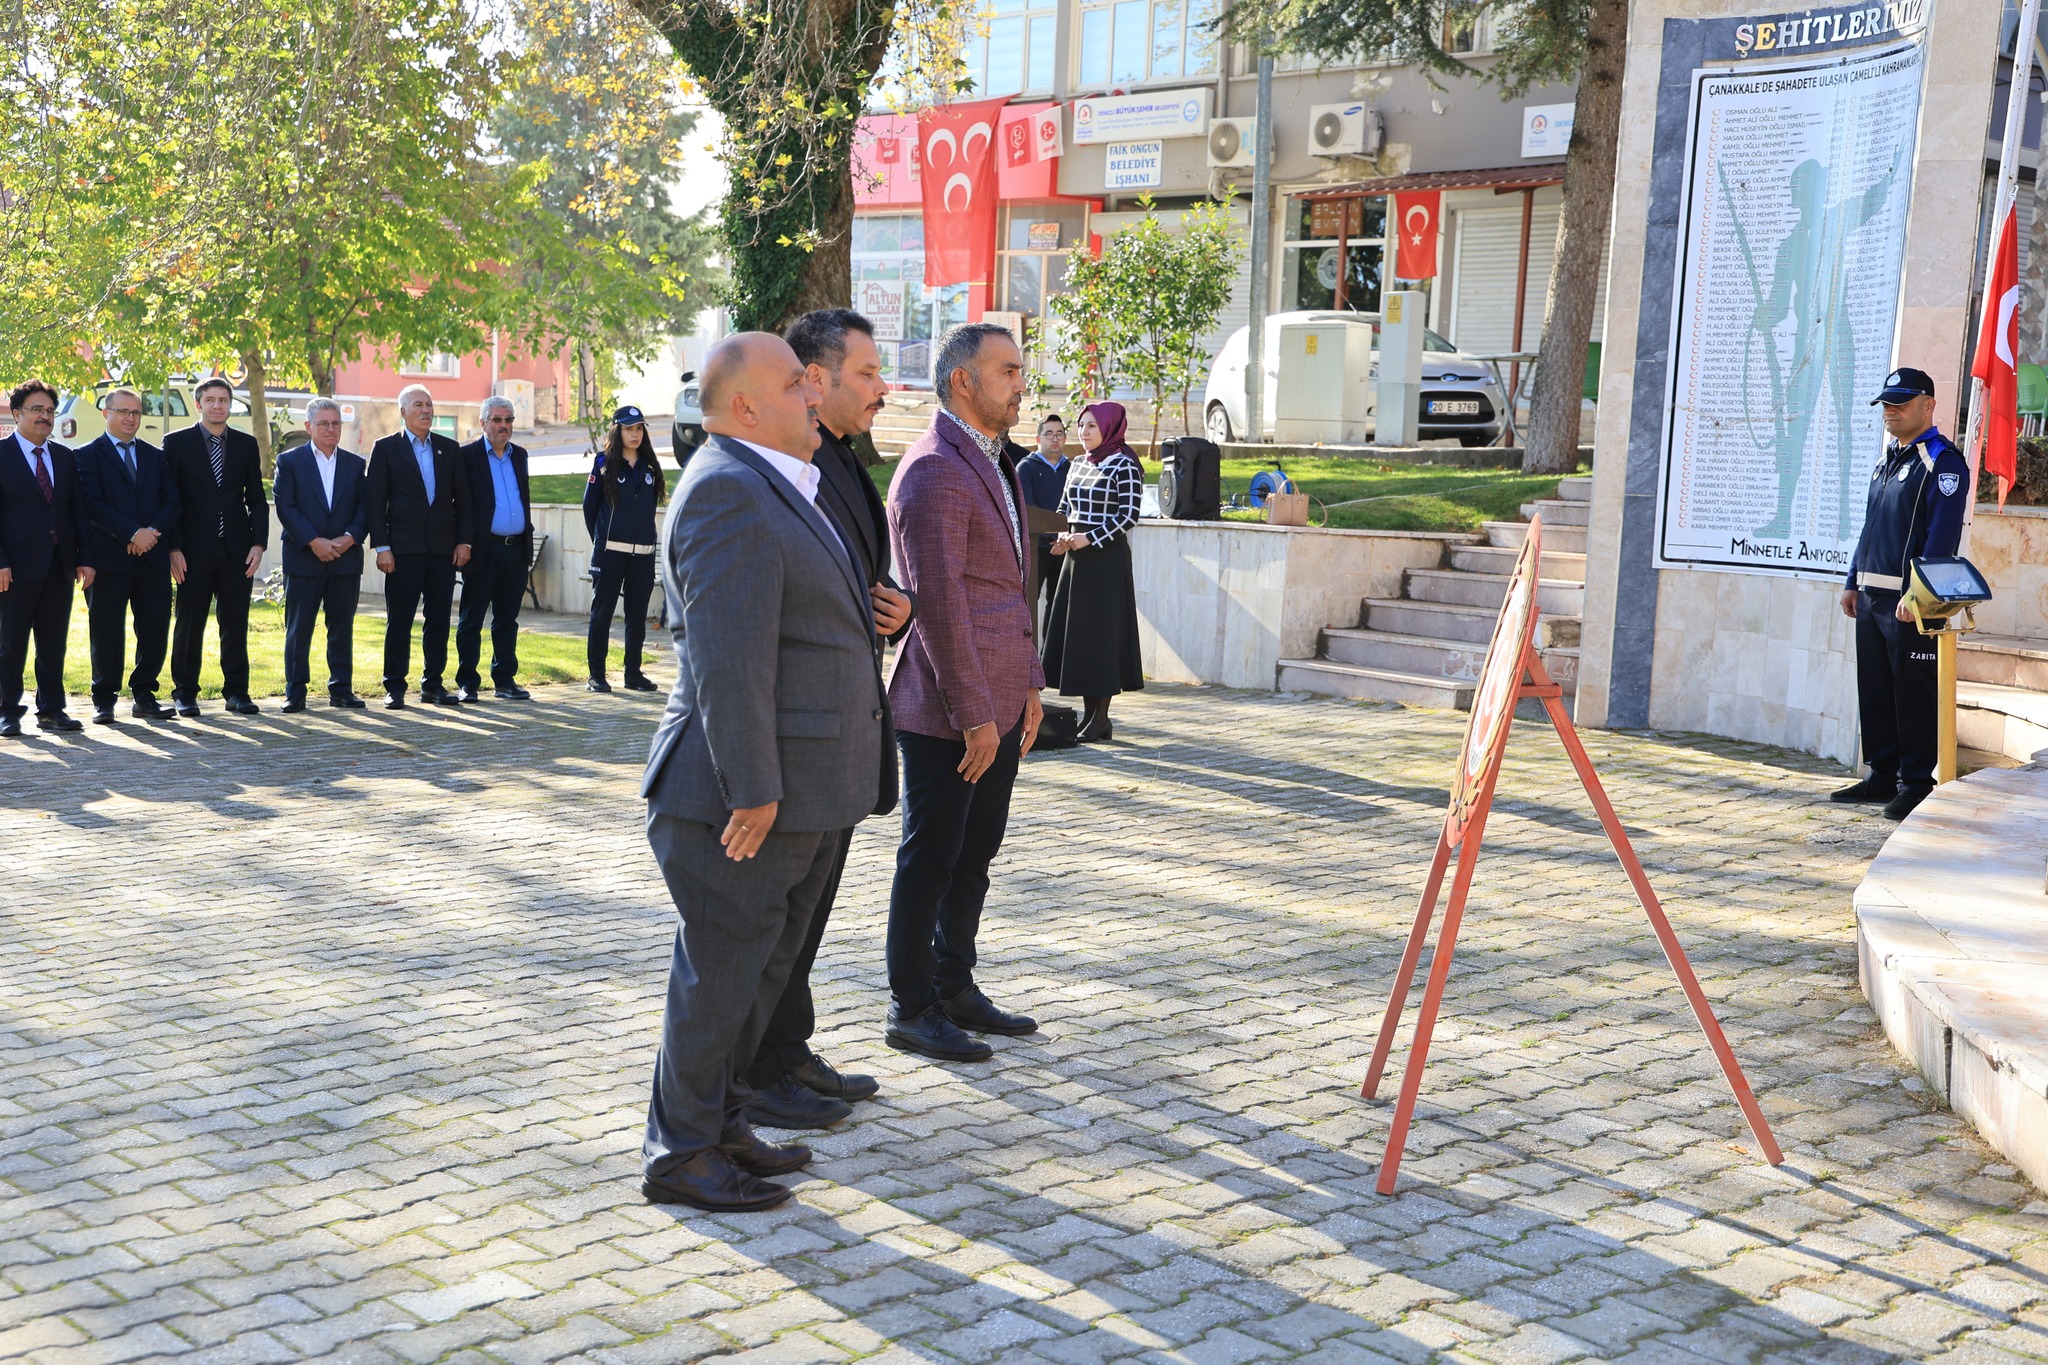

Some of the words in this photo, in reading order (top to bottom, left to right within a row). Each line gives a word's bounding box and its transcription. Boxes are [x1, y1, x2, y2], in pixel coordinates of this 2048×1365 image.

[1708, 82, 1773, 98] ÇANAKKALE'DE
[1775, 77, 1818, 94] ŞAHADETE
[1820, 72, 1849, 88] ULAŞAN
[1116, 105, 1152, 115] BÜYÜKŞEHİR
[1769, 122, 1786, 130] OĞLU
[1130, 144, 1159, 154] ONGUN
[1110, 158, 1156, 170] BELEDİYE
[1743, 158, 1760, 166] OĞLU
[1732, 167, 1749, 175] OĞLU
[1116, 174, 1149, 186] İŞHANI
[1738, 201, 1756, 210] OĞLU
[1738, 210, 1755, 218] OĞLU
[1314, 218, 1357, 228] EVRN
[869, 294, 901, 304] ALTUN
[1701, 381, 1736, 390] KELEŞOĞLU
[1433, 403, 1442, 411] 20
[1448, 403, 1452, 411] E
[1457, 403, 1477, 411] 3769
[1722, 473, 1738, 481] OĞLU
[1728, 482, 1745, 490] OĞLU
[1727, 490, 1744, 498] OĞLU
[1743, 499, 1758, 507] OĞLU
[1798, 541, 1848, 565] ANIYORUZ
[1910, 652, 1936, 660] ZABITA
